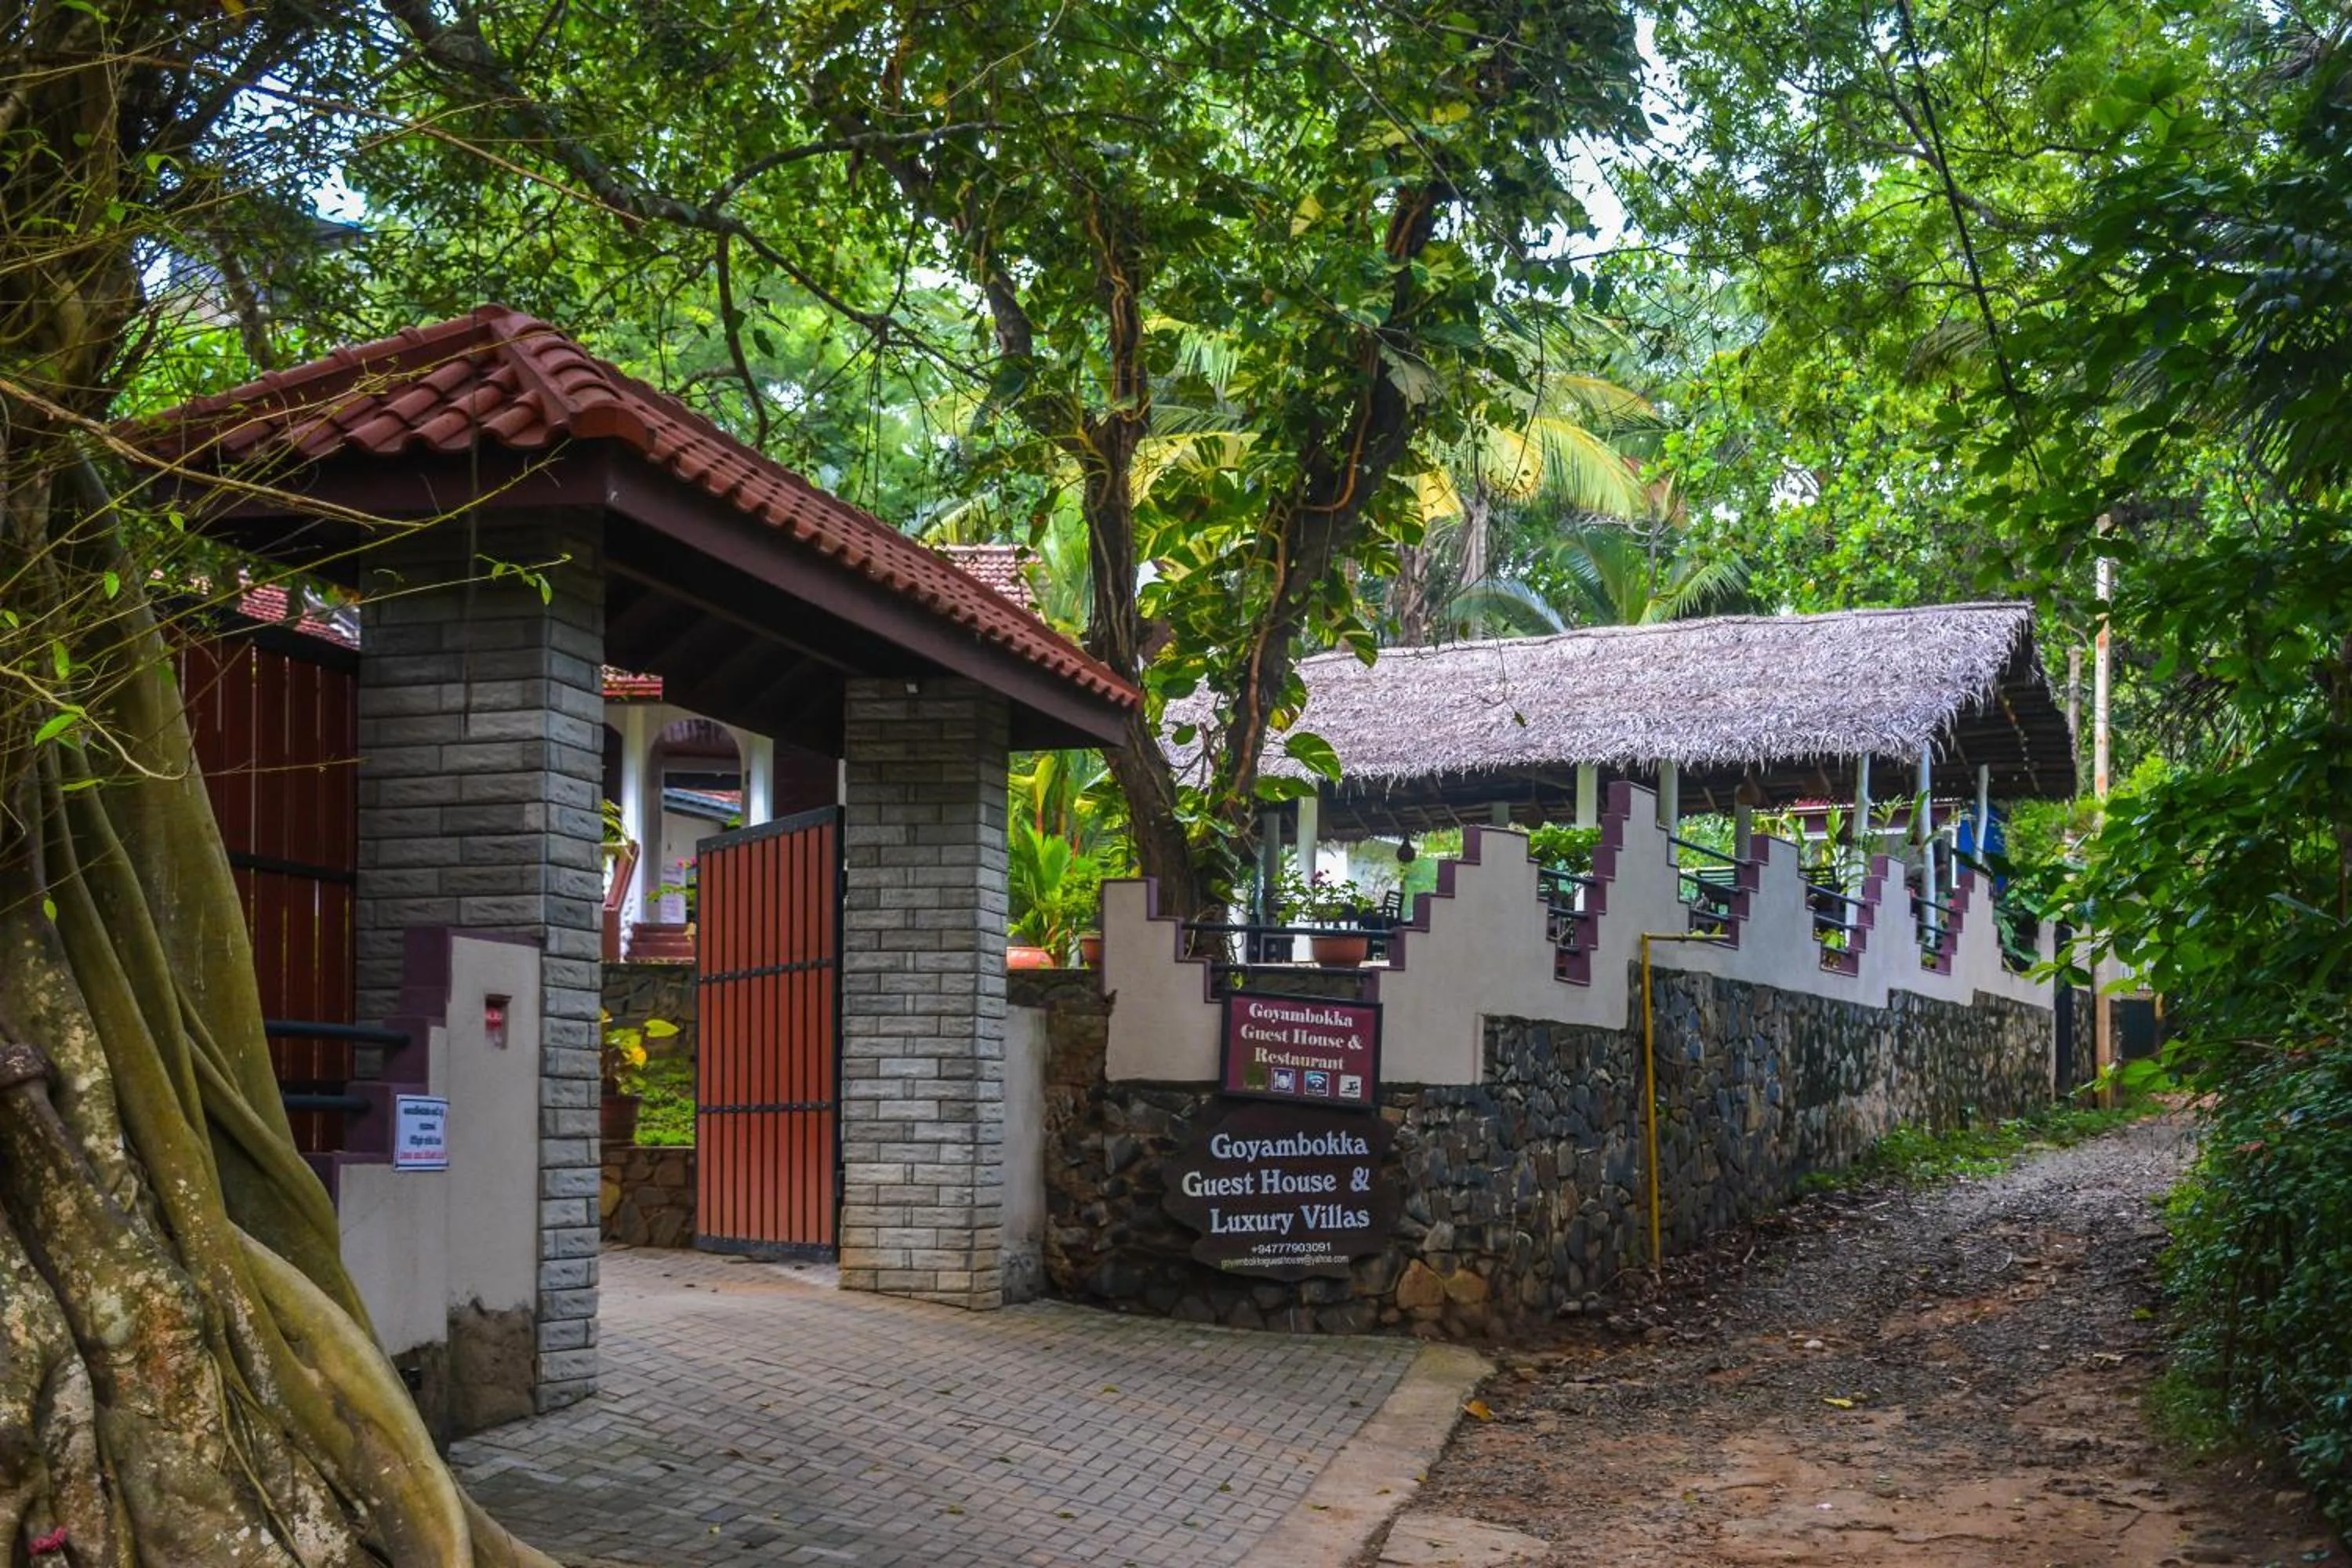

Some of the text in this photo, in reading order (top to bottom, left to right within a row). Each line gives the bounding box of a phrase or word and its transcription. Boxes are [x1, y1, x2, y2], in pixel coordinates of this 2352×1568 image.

[1249, 1003, 1353, 1028] Goyambokka
[1240, 1024, 1363, 1051] Guest House &
[1254, 1047, 1344, 1070] Restaurant
[1210, 1131, 1370, 1163] Goyambokka
[1181, 1167, 1370, 1197] Guest House &
[1210, 1204, 1370, 1235] Luxury Villas
